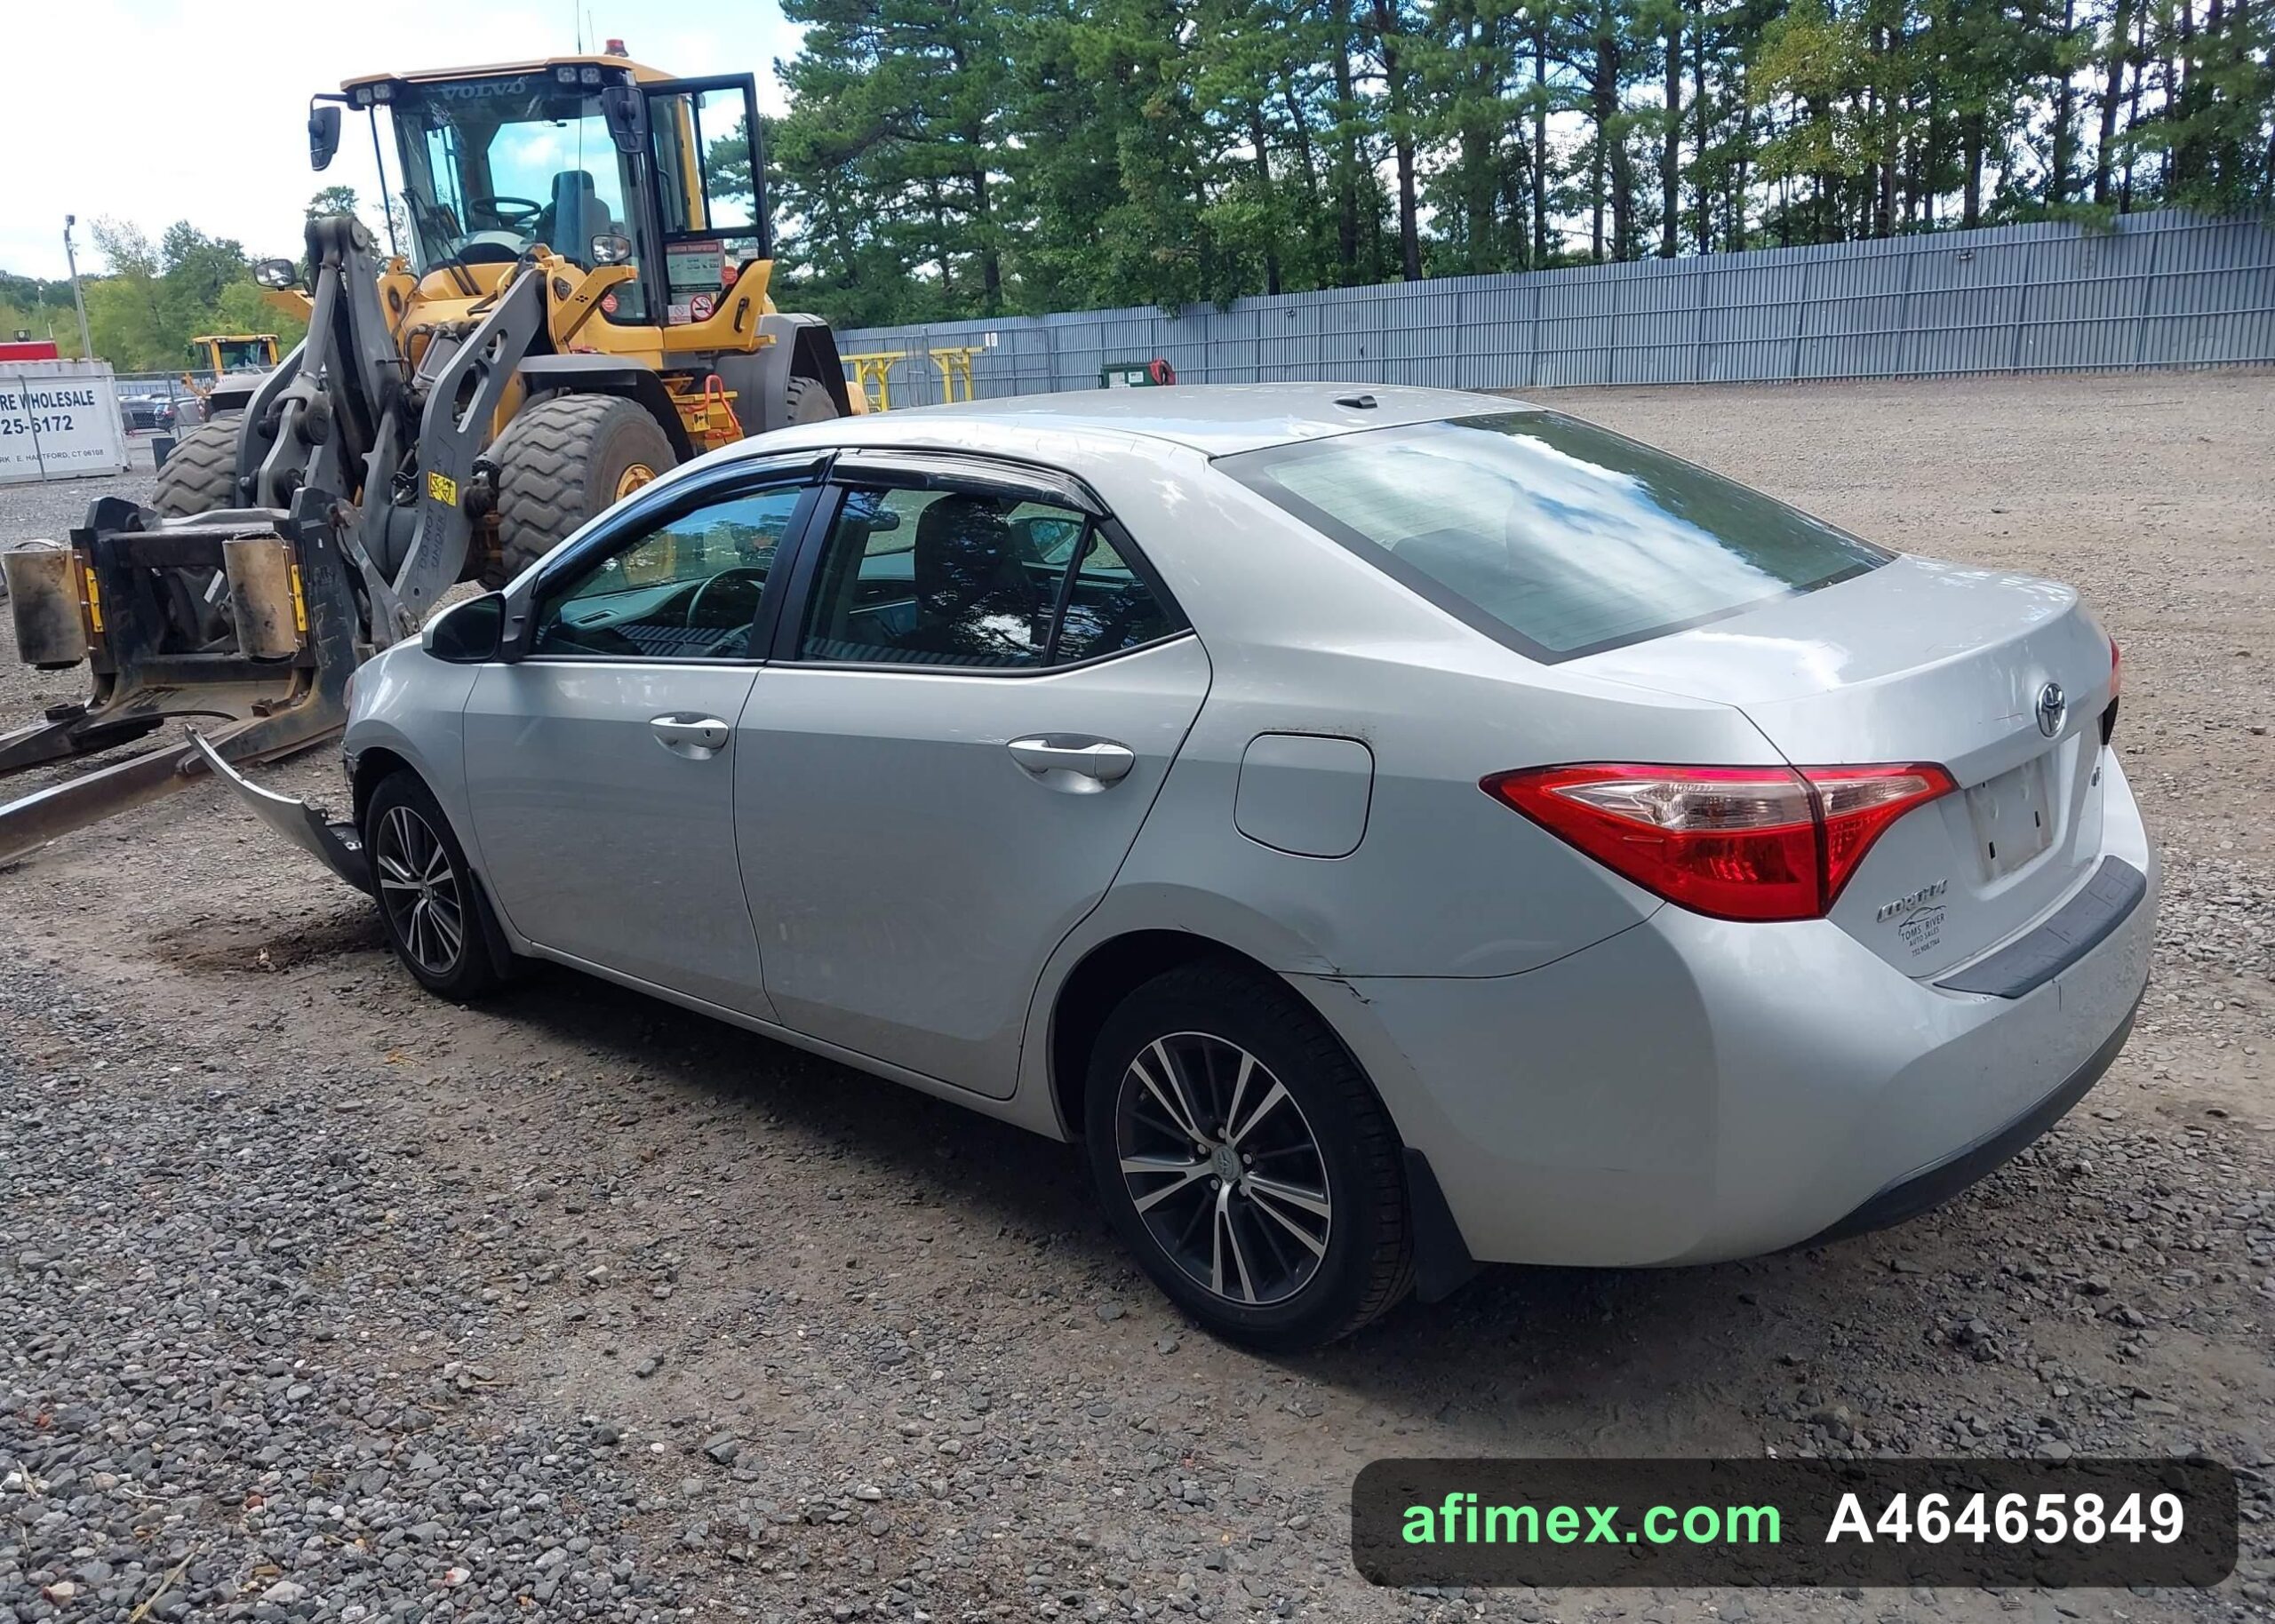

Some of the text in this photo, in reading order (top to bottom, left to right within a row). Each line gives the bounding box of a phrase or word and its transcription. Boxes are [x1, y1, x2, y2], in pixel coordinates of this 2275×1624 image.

[441, 81, 526, 100] VOLVO
[19, 390, 95, 410] WHOLESALE
[1901, 912, 1944, 942] TOMS RIVER
[1909, 926, 1940, 947] AUTO SALES
